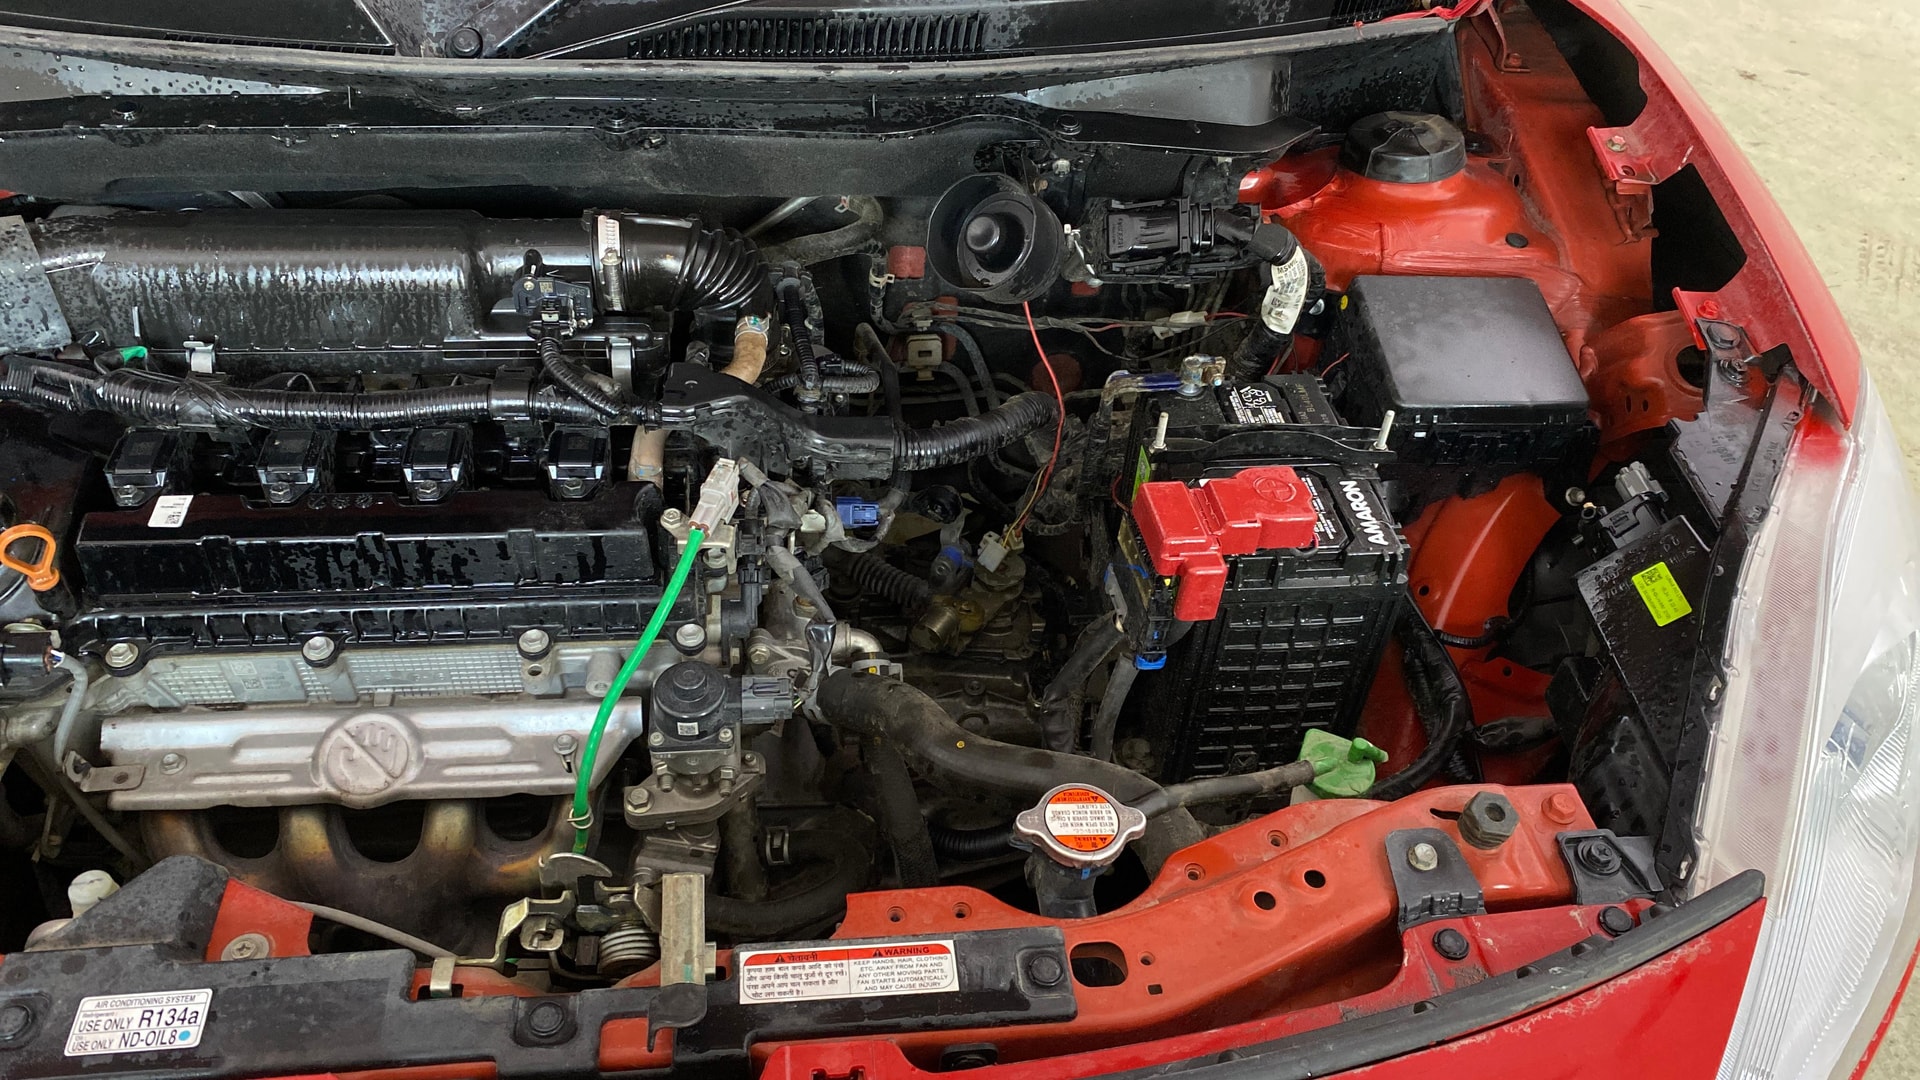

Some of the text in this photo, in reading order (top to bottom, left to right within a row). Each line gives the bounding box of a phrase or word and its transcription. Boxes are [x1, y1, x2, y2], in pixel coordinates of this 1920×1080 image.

[1339, 481, 1389, 545] AMARON
[787, 952, 818, 962] चेतावनी
[884, 947, 930, 956] WARNING
[110, 998, 163, 1007] CONDITIONING
[165, 995, 196, 1004] SYSTEM
[78, 1007, 199, 1032] USE ONLY R134a
[72, 1029, 178, 1052] USE ONLY ND-OIL8
